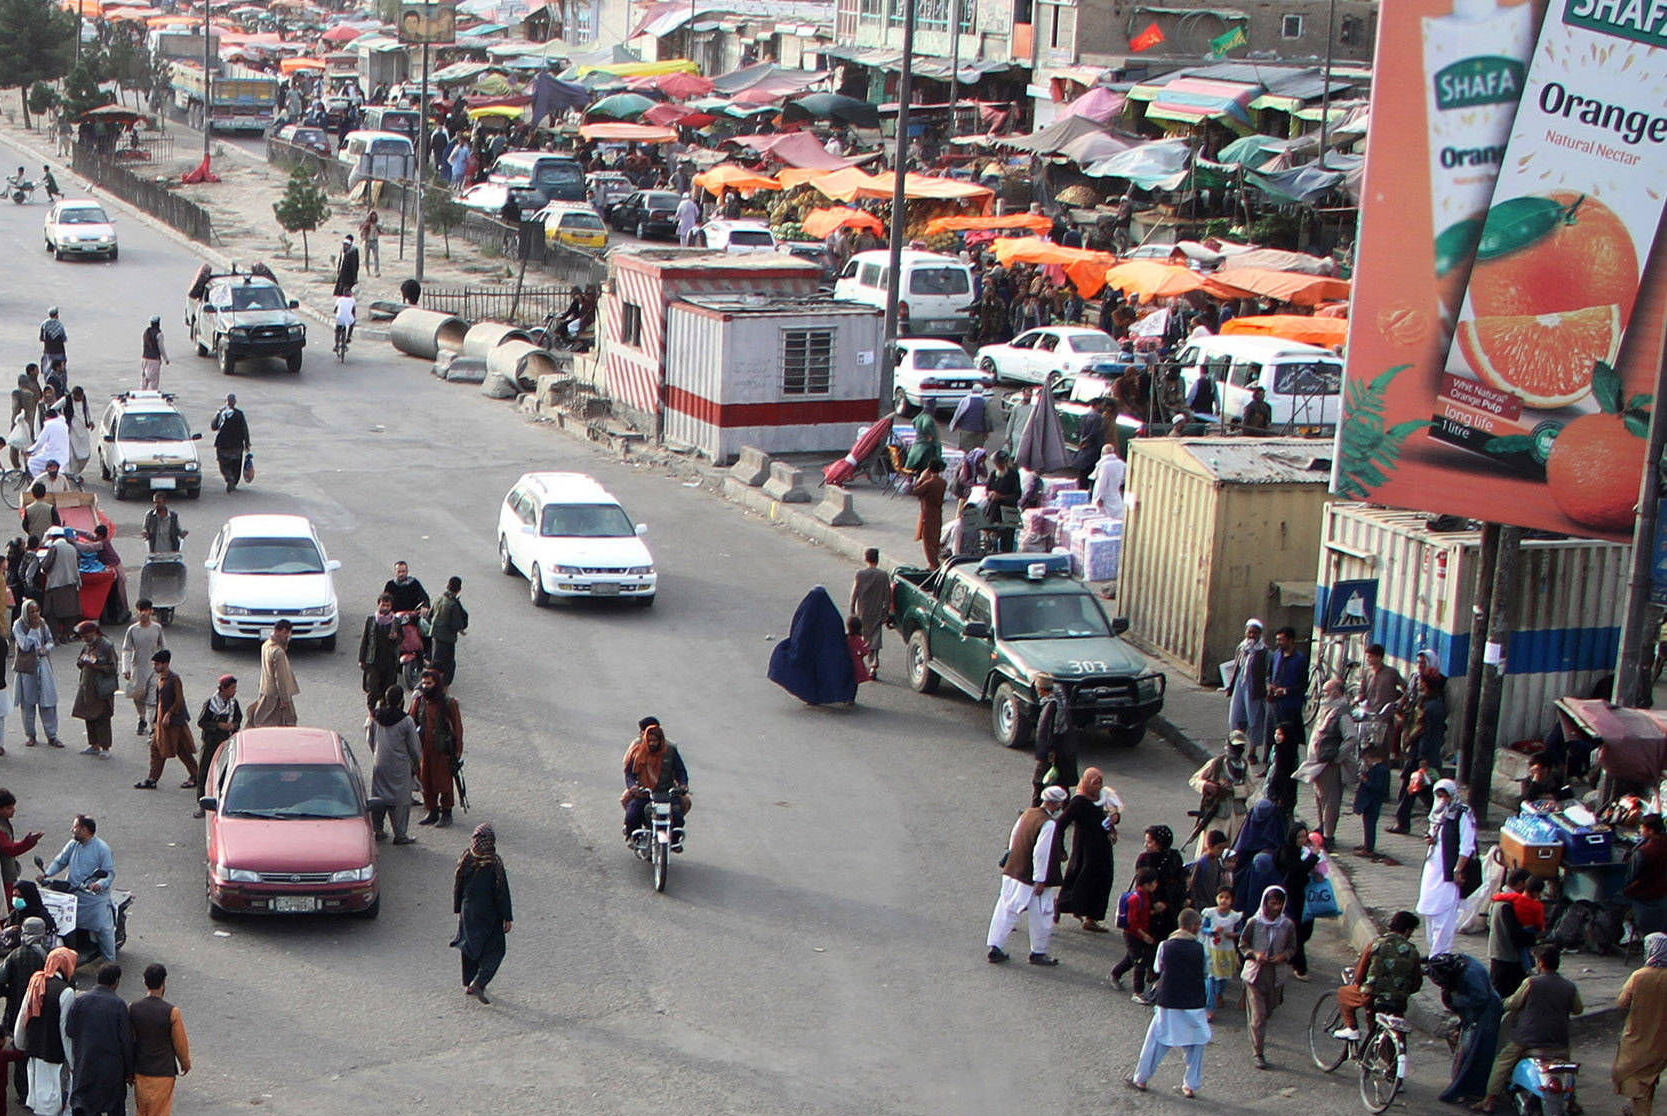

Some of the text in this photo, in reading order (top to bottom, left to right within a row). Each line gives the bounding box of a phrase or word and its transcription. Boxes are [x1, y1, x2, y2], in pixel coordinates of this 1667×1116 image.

[1441, 67, 1515, 101] SHAFA
[1539, 82, 1667, 145] Orange
[1440, 145, 1506, 170] Oran
[1545, 130, 1641, 167] Natural Nectar
[1450, 388, 1503, 413] Orange Pulp
[1445, 404, 1494, 432] long life
[1448, 421, 1470, 438] litre
[1068, 660, 1107, 674] 307
